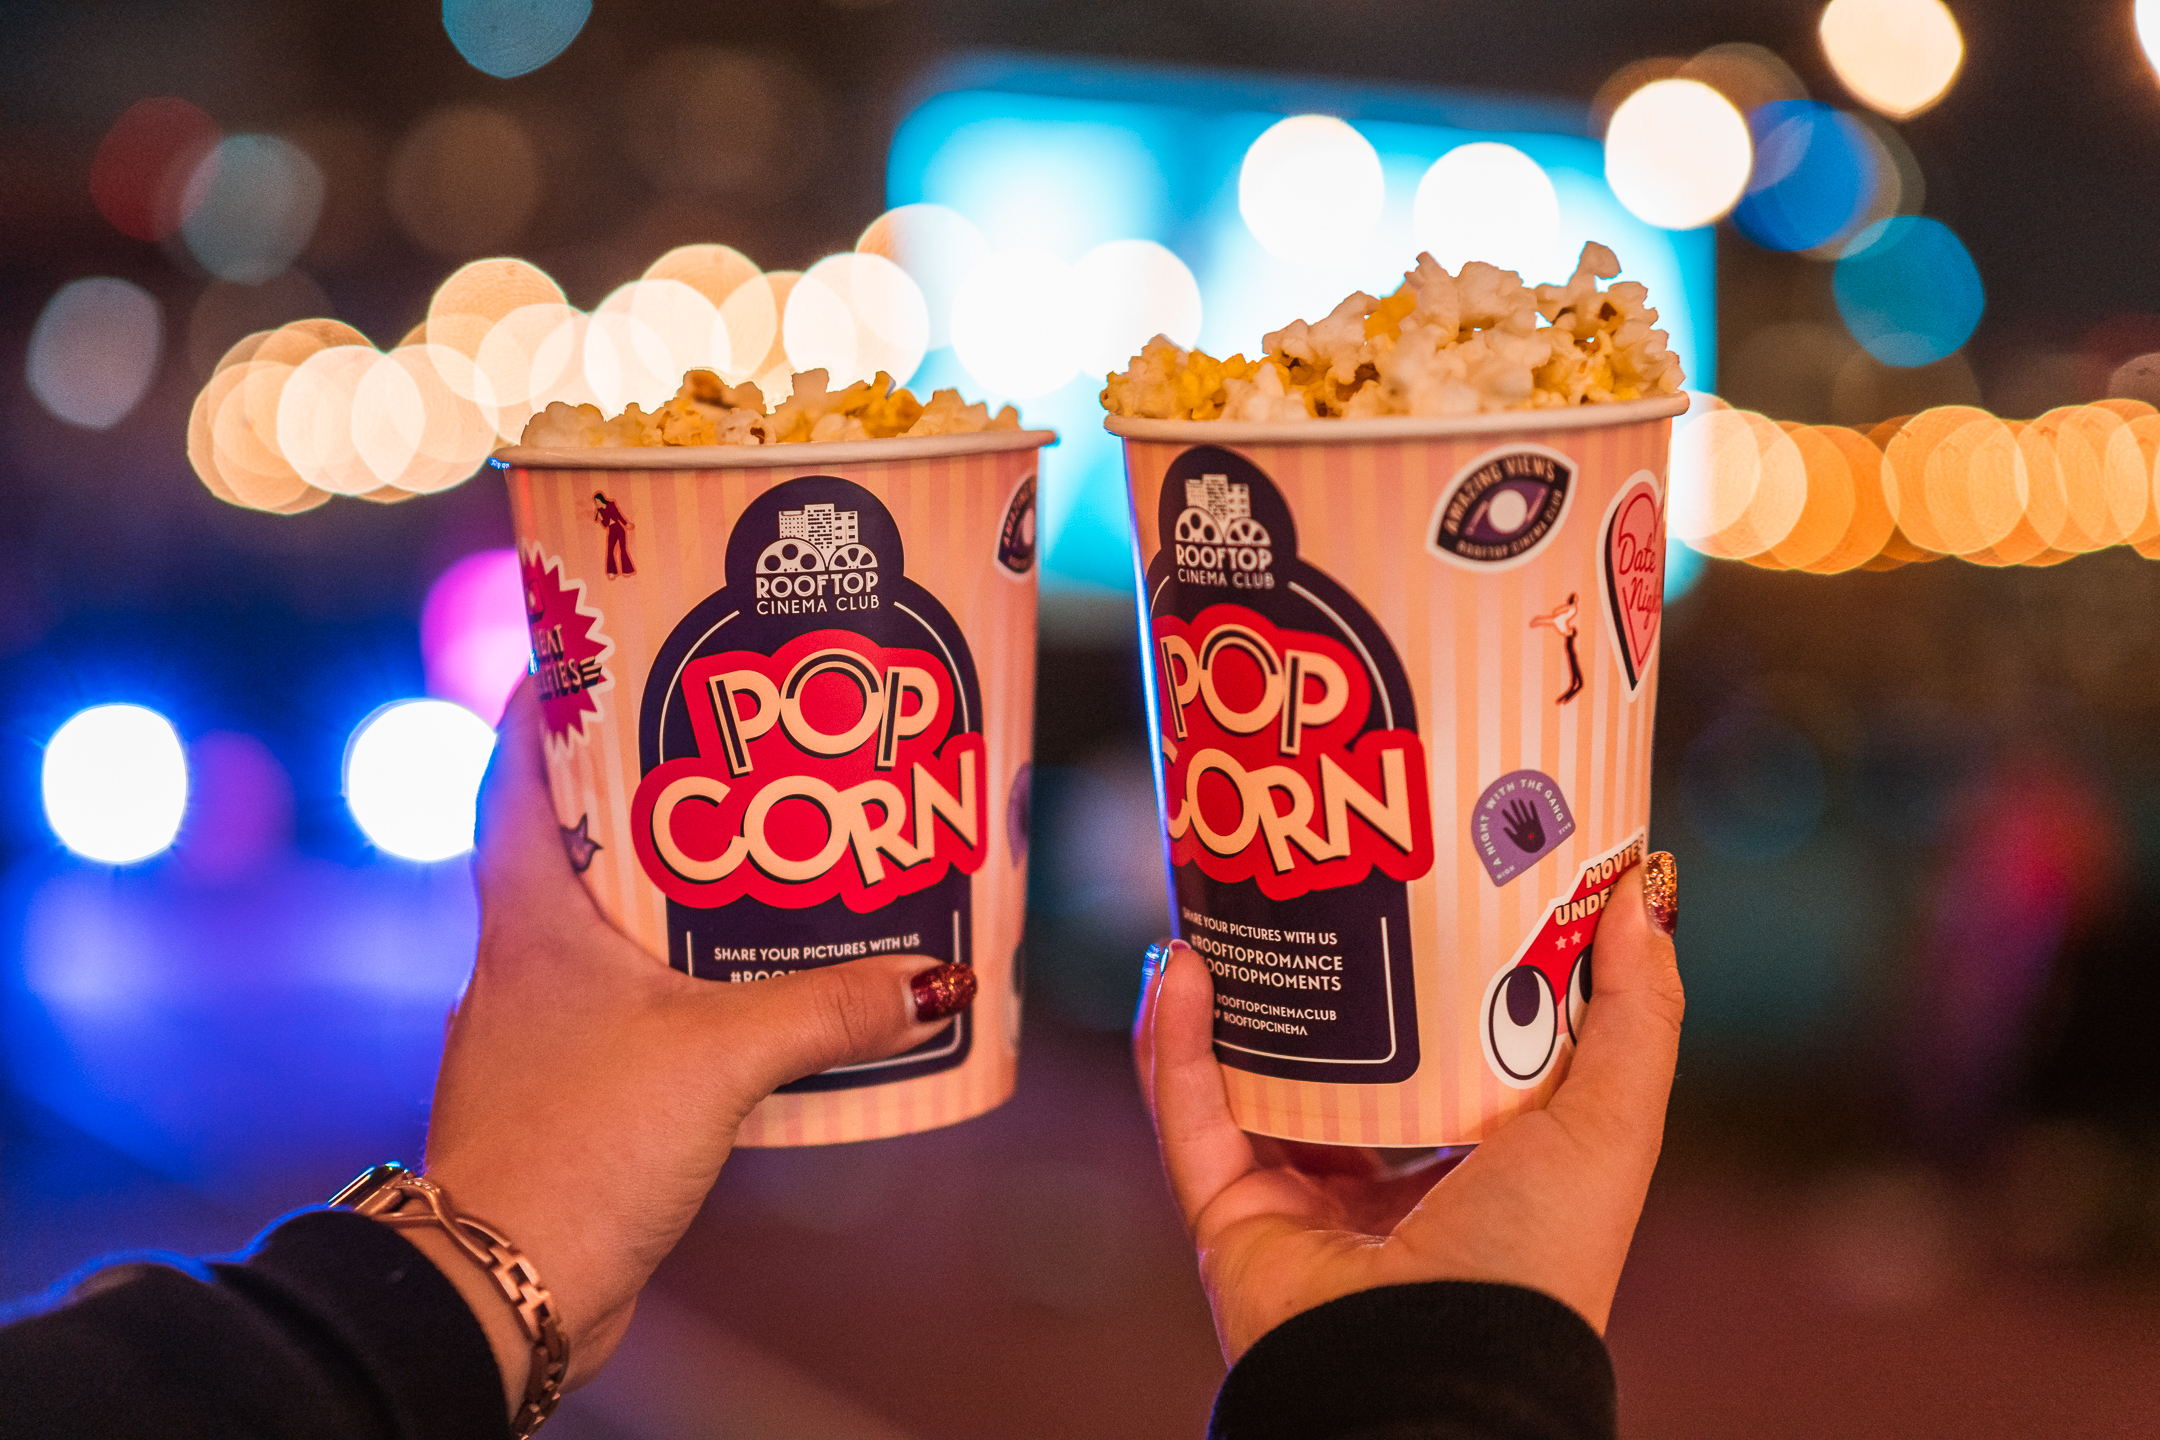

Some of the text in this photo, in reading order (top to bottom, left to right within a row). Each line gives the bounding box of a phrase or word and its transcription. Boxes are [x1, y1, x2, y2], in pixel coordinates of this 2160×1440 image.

[1444, 454, 1556, 534] AMAZING VIEWS
[1175, 544, 1273, 571] ROOFTOP
[1619, 531, 1656, 575] Date
[756, 570, 879, 600] ROOFTOP
[1177, 568, 1275, 589] CINEMA CLUB
[756, 594, 880, 616] CINEMA CLUB
[1160, 623, 1349, 757] POP
[708, 647, 940, 778] POP
[1484, 781, 1517, 811] WITH
[1520, 778, 1544, 792] THE
[650, 749, 979, 890] CORN
[1543, 788, 1565, 823] GANG
[1479, 813, 1497, 857] NIGHT
[1555, 883, 1617, 927] UNDE
[714, 933, 920, 961] SHARE YOUR PICTURES WITH US
[1203, 914, 1228, 934] YOUR
[1229, 922, 1282, 943] PICTURES
[1283, 929, 1317, 945] WITH
[1318, 931, 1338, 946] US
[1191, 933, 1344, 971] #ROOFTOPROMANCE
[1206, 957, 1343, 992] OOFTOPMOMENTS
[1223, 1010, 1309, 1036] ROOFTOPCINEMA
